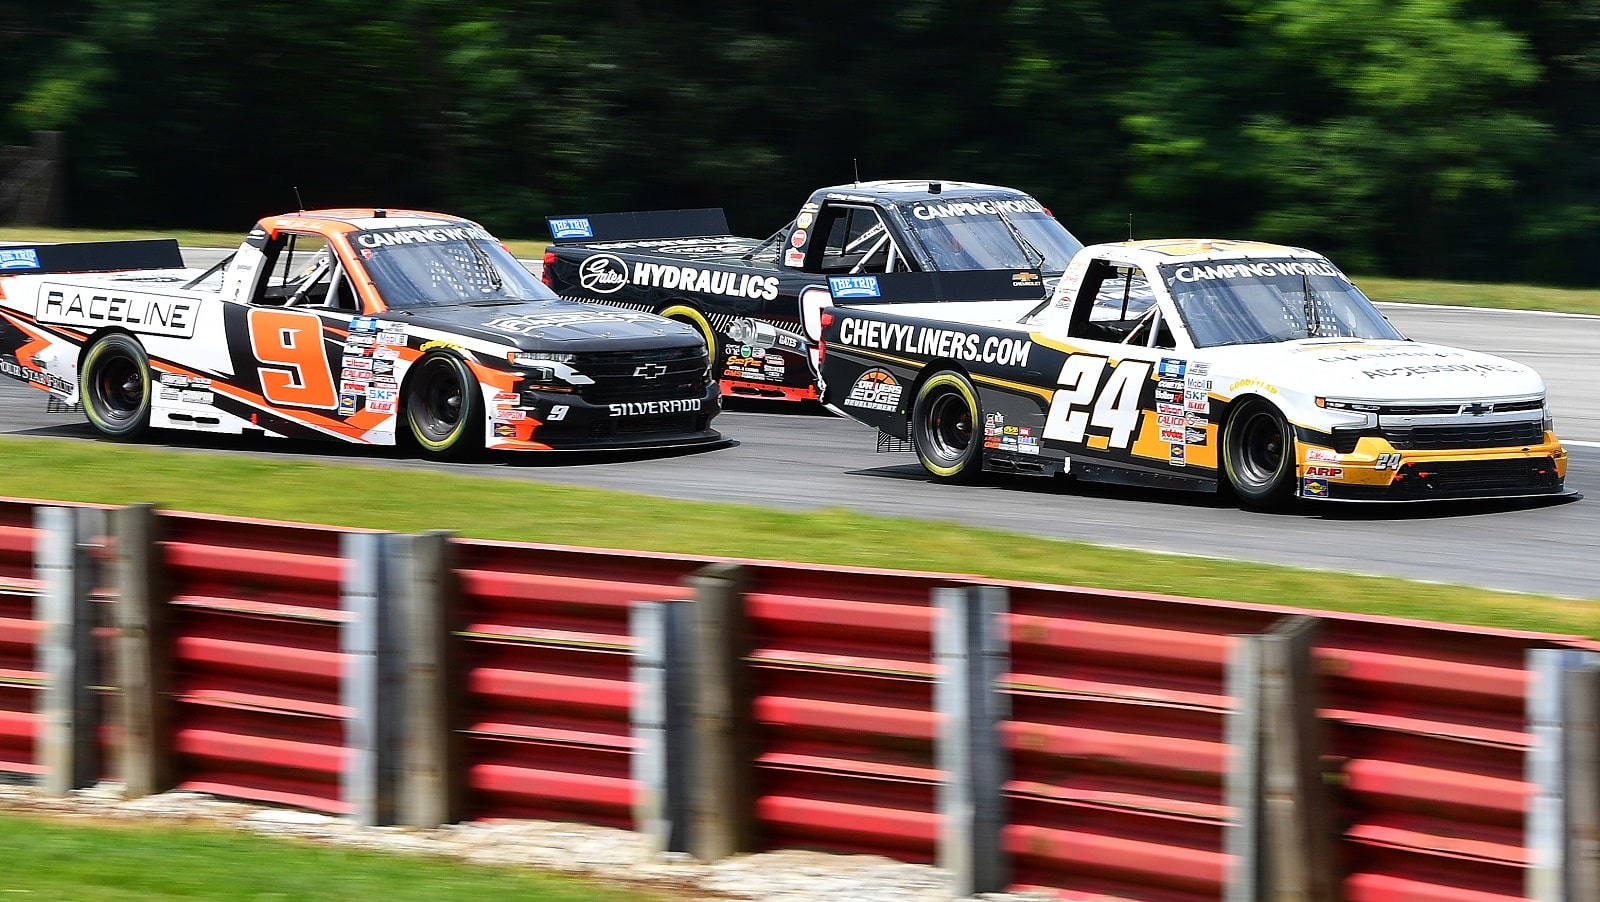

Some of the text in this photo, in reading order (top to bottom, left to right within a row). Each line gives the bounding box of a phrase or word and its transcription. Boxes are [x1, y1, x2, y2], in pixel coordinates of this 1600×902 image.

[913, 199, 1043, 220] CAMPING WORLD
[550, 219, 589, 232] THE TRIP
[358, 227, 500, 248] CAMPING WORLD
[583, 259, 626, 287] Gates
[633, 262, 780, 300] HYDRAULICS
[1175, 262, 1338, 283] CAMPING WORLD
[830, 277, 876, 291] THE TRIP
[45, 290, 190, 329] RACELINE
[779, 335, 798, 348] GATES
[839, 317, 1032, 367] CHEVYLINERS.COM
[249, 308, 338, 409] 9
[1187, 378, 1206, 388] Mobil
[368, 389, 396, 399] SKF
[850, 388, 901, 405] EDGE
[1041, 353, 1154, 449] 24
[1185, 390, 1207, 400] SKF
[546, 404, 570, 421] 9
[608, 398, 701, 417] SILVERADO
[843, 398, 898, 413] DEVELOPMENT
[1157, 415, 1185, 426] CALICO
[1374, 453, 1401, 471] 24
[1306, 466, 1342, 477] ARP
